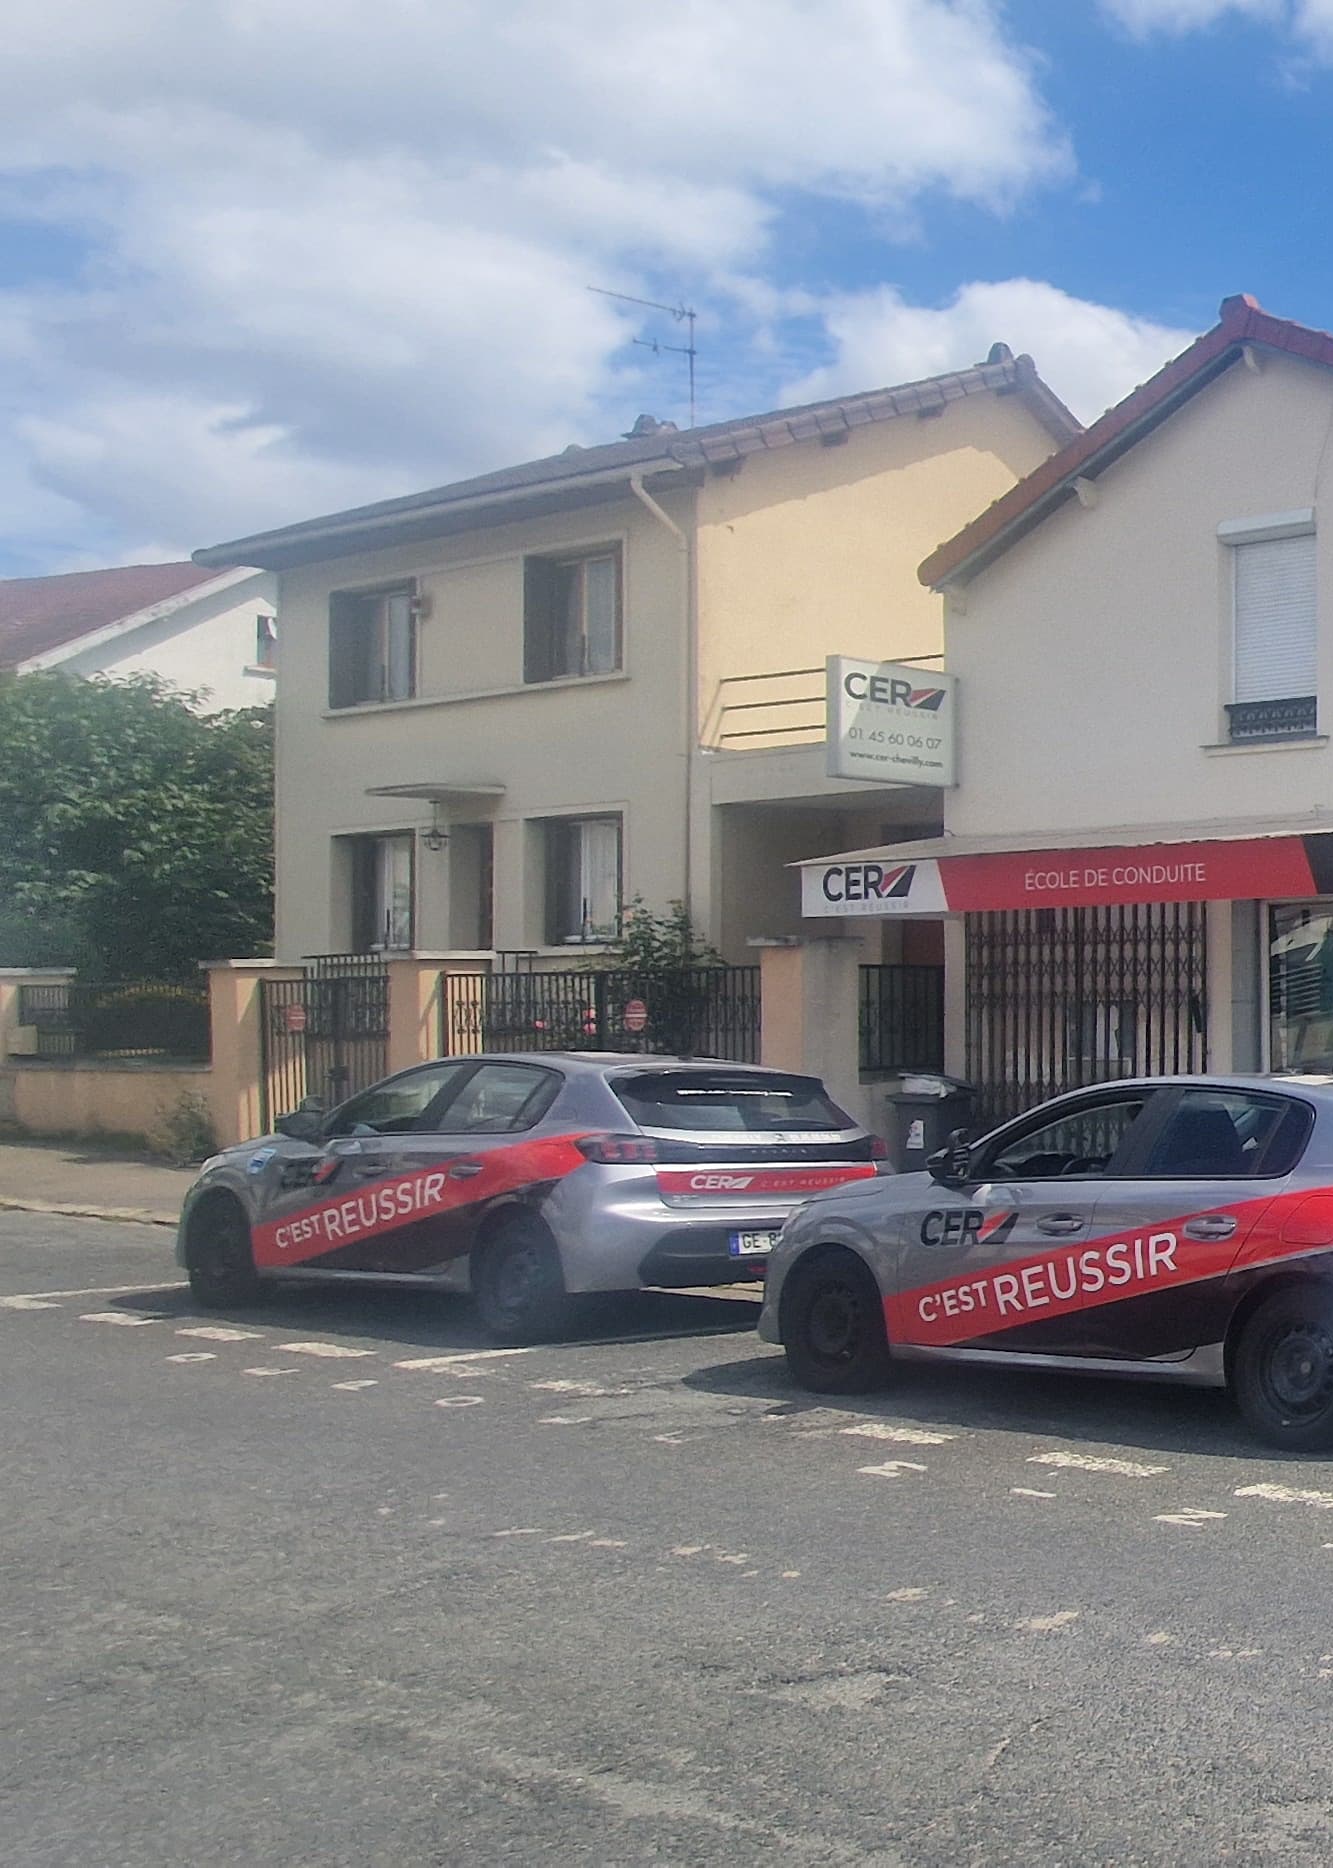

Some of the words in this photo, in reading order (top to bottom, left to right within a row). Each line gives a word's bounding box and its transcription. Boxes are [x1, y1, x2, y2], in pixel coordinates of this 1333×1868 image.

[844, 672, 913, 708] CER
[848, 727, 863, 739] 01
[868, 731, 884, 743] 45
[888, 733, 904, 746] 60
[907, 735, 923, 748] 06
[926, 737, 942, 750] 07
[850, 752, 943, 769] www.cer-chevilly.com
[823, 864, 883, 902] CER
[1025, 868, 1080, 891] ÉCOLE
[1084, 868, 1108, 888] DE
[1112, 863, 1206, 885] CONDUITE
[690, 1174, 732, 1190] CER
[275, 1213, 321, 1248] C'EST
[323, 1172, 446, 1241] REUSSIR
[920, 1210, 984, 1246] CER
[918, 1280, 988, 1322] C'EST
[993, 1232, 1178, 1315] REUSSIR
